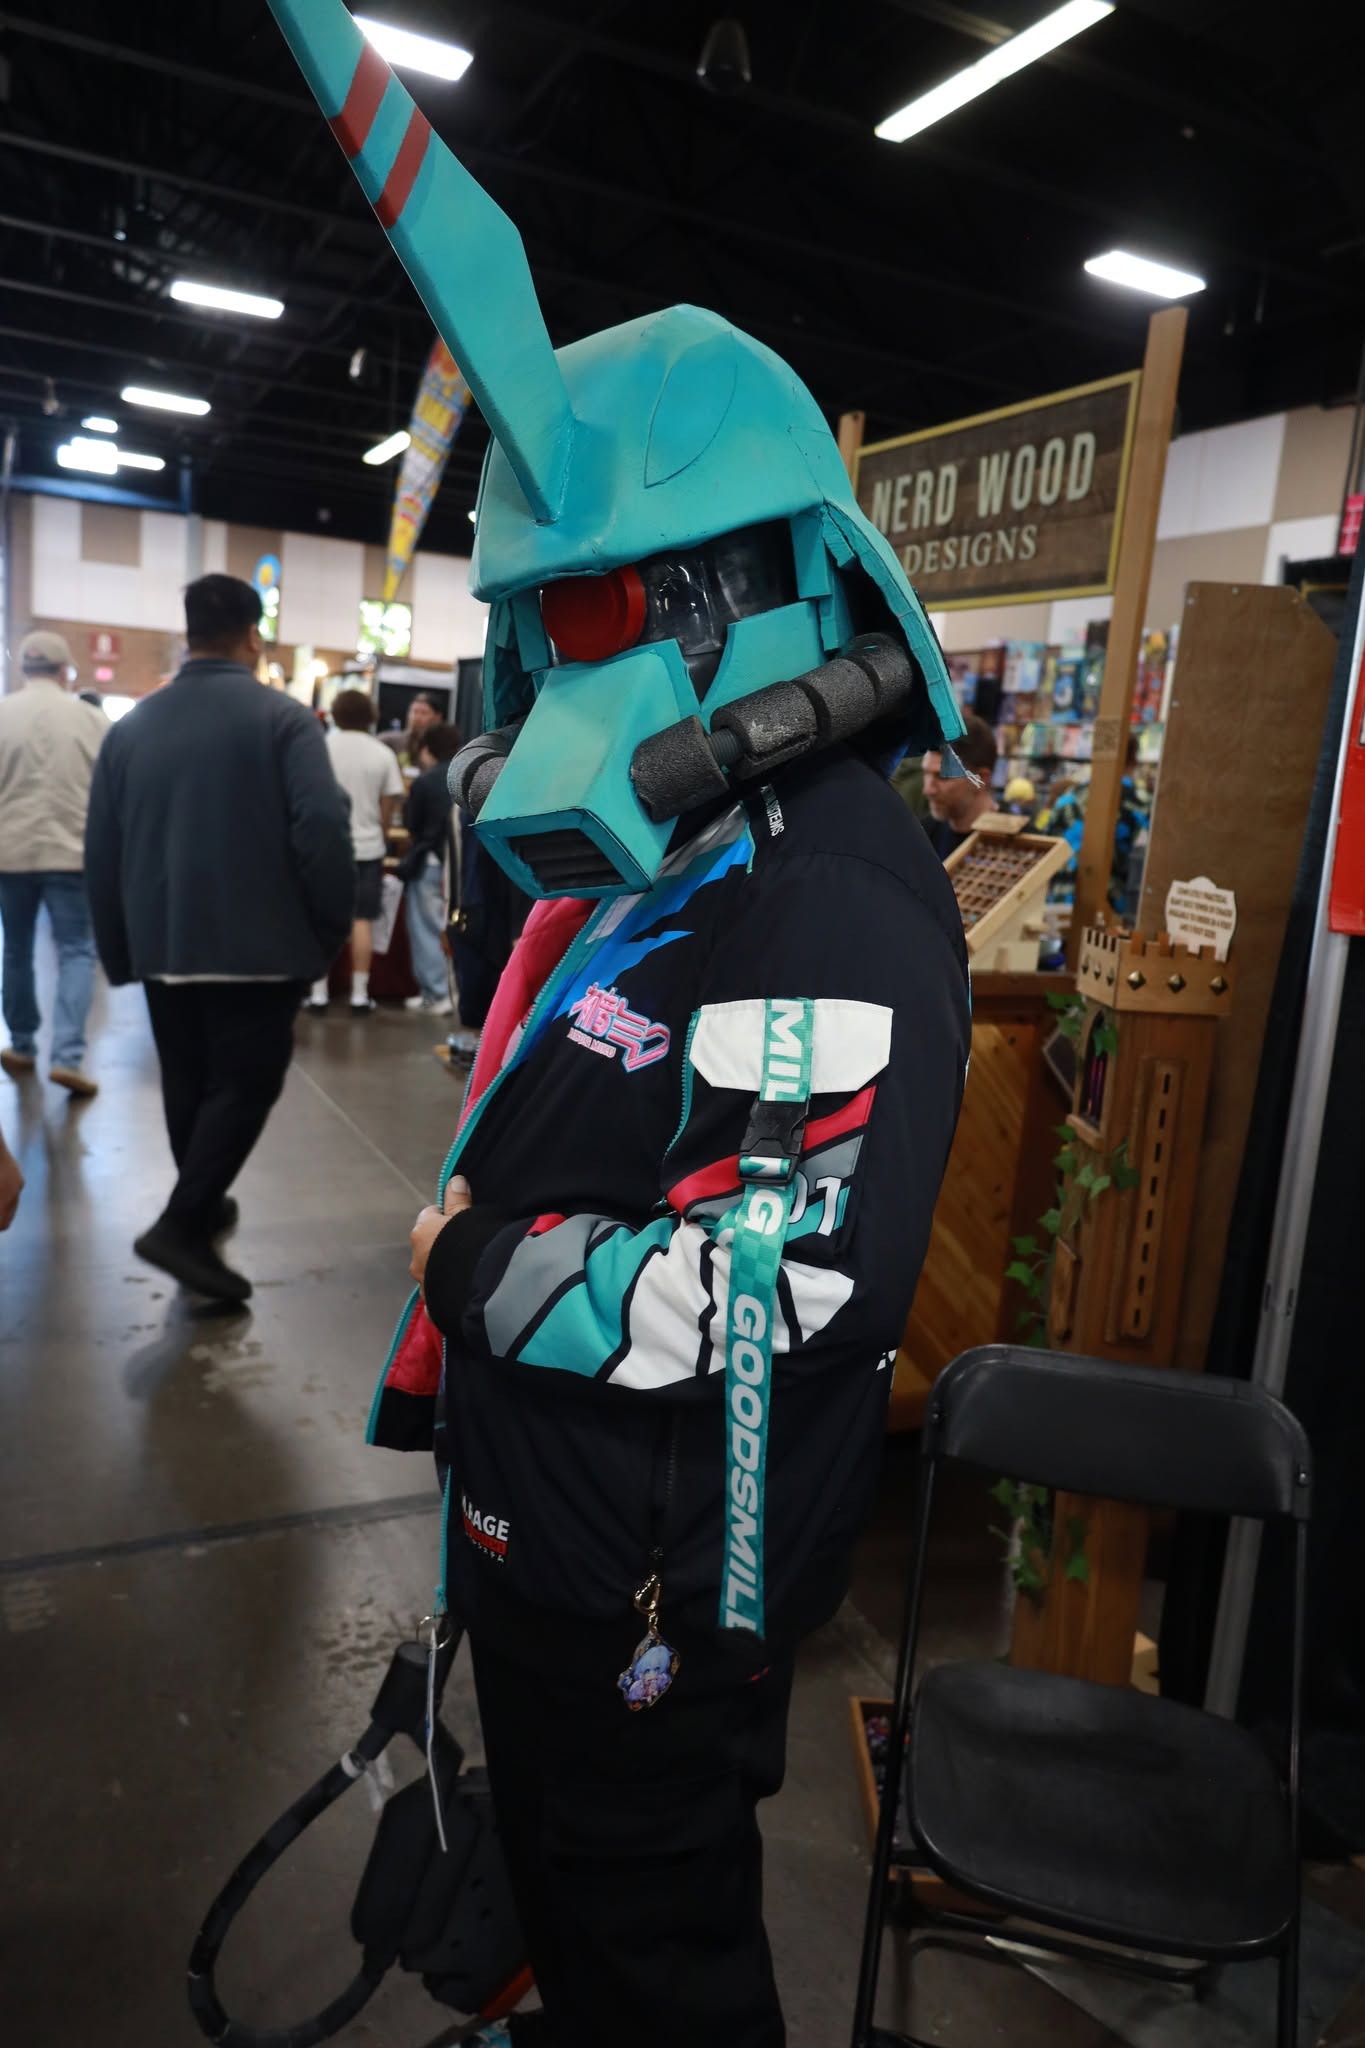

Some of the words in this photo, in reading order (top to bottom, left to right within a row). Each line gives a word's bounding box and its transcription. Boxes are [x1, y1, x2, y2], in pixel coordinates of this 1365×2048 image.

[872, 464, 957, 536] NERD
[978, 432, 1095, 518] WOOD
[903, 525, 1037, 576] DESIGNS
